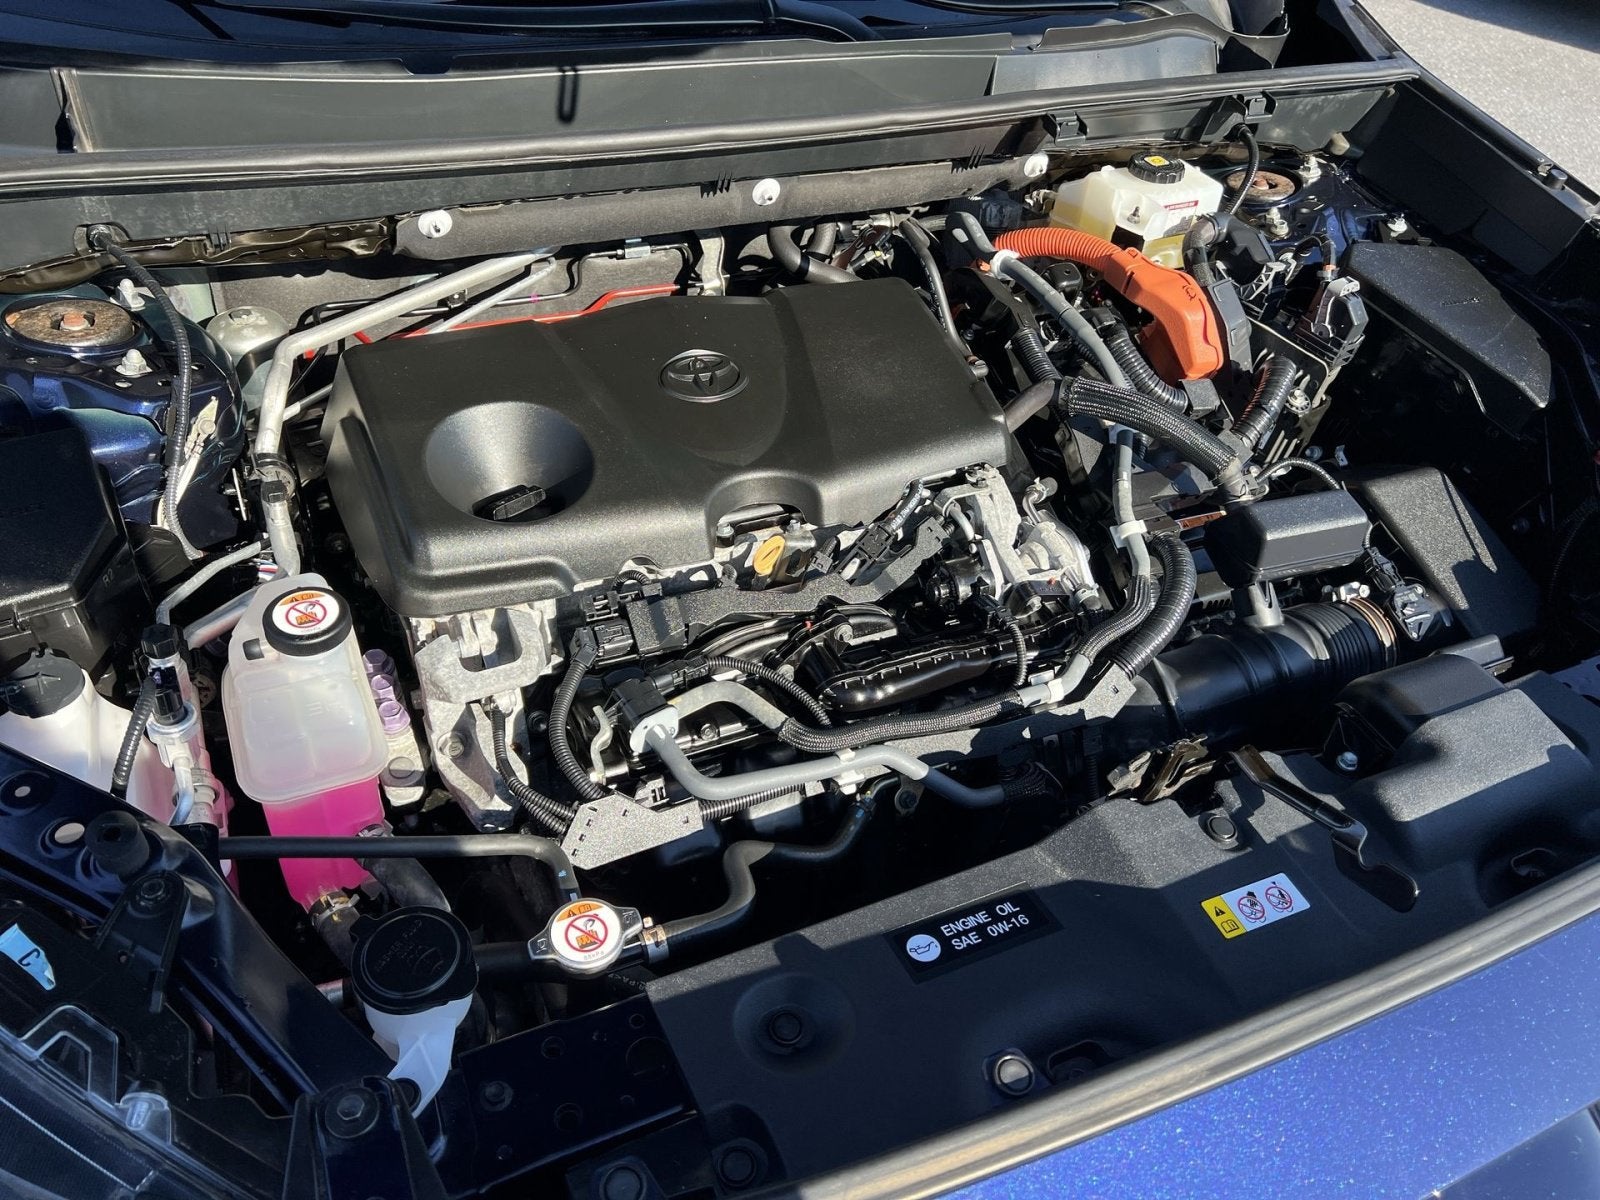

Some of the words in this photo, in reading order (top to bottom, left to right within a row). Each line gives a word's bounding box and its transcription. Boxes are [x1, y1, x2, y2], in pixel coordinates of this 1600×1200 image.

[940, 911, 992, 937] ENGINE
[996, 901, 1020, 916] OIL
[951, 931, 982, 950] SAE
[987, 914, 1030, 937] 0W-16
